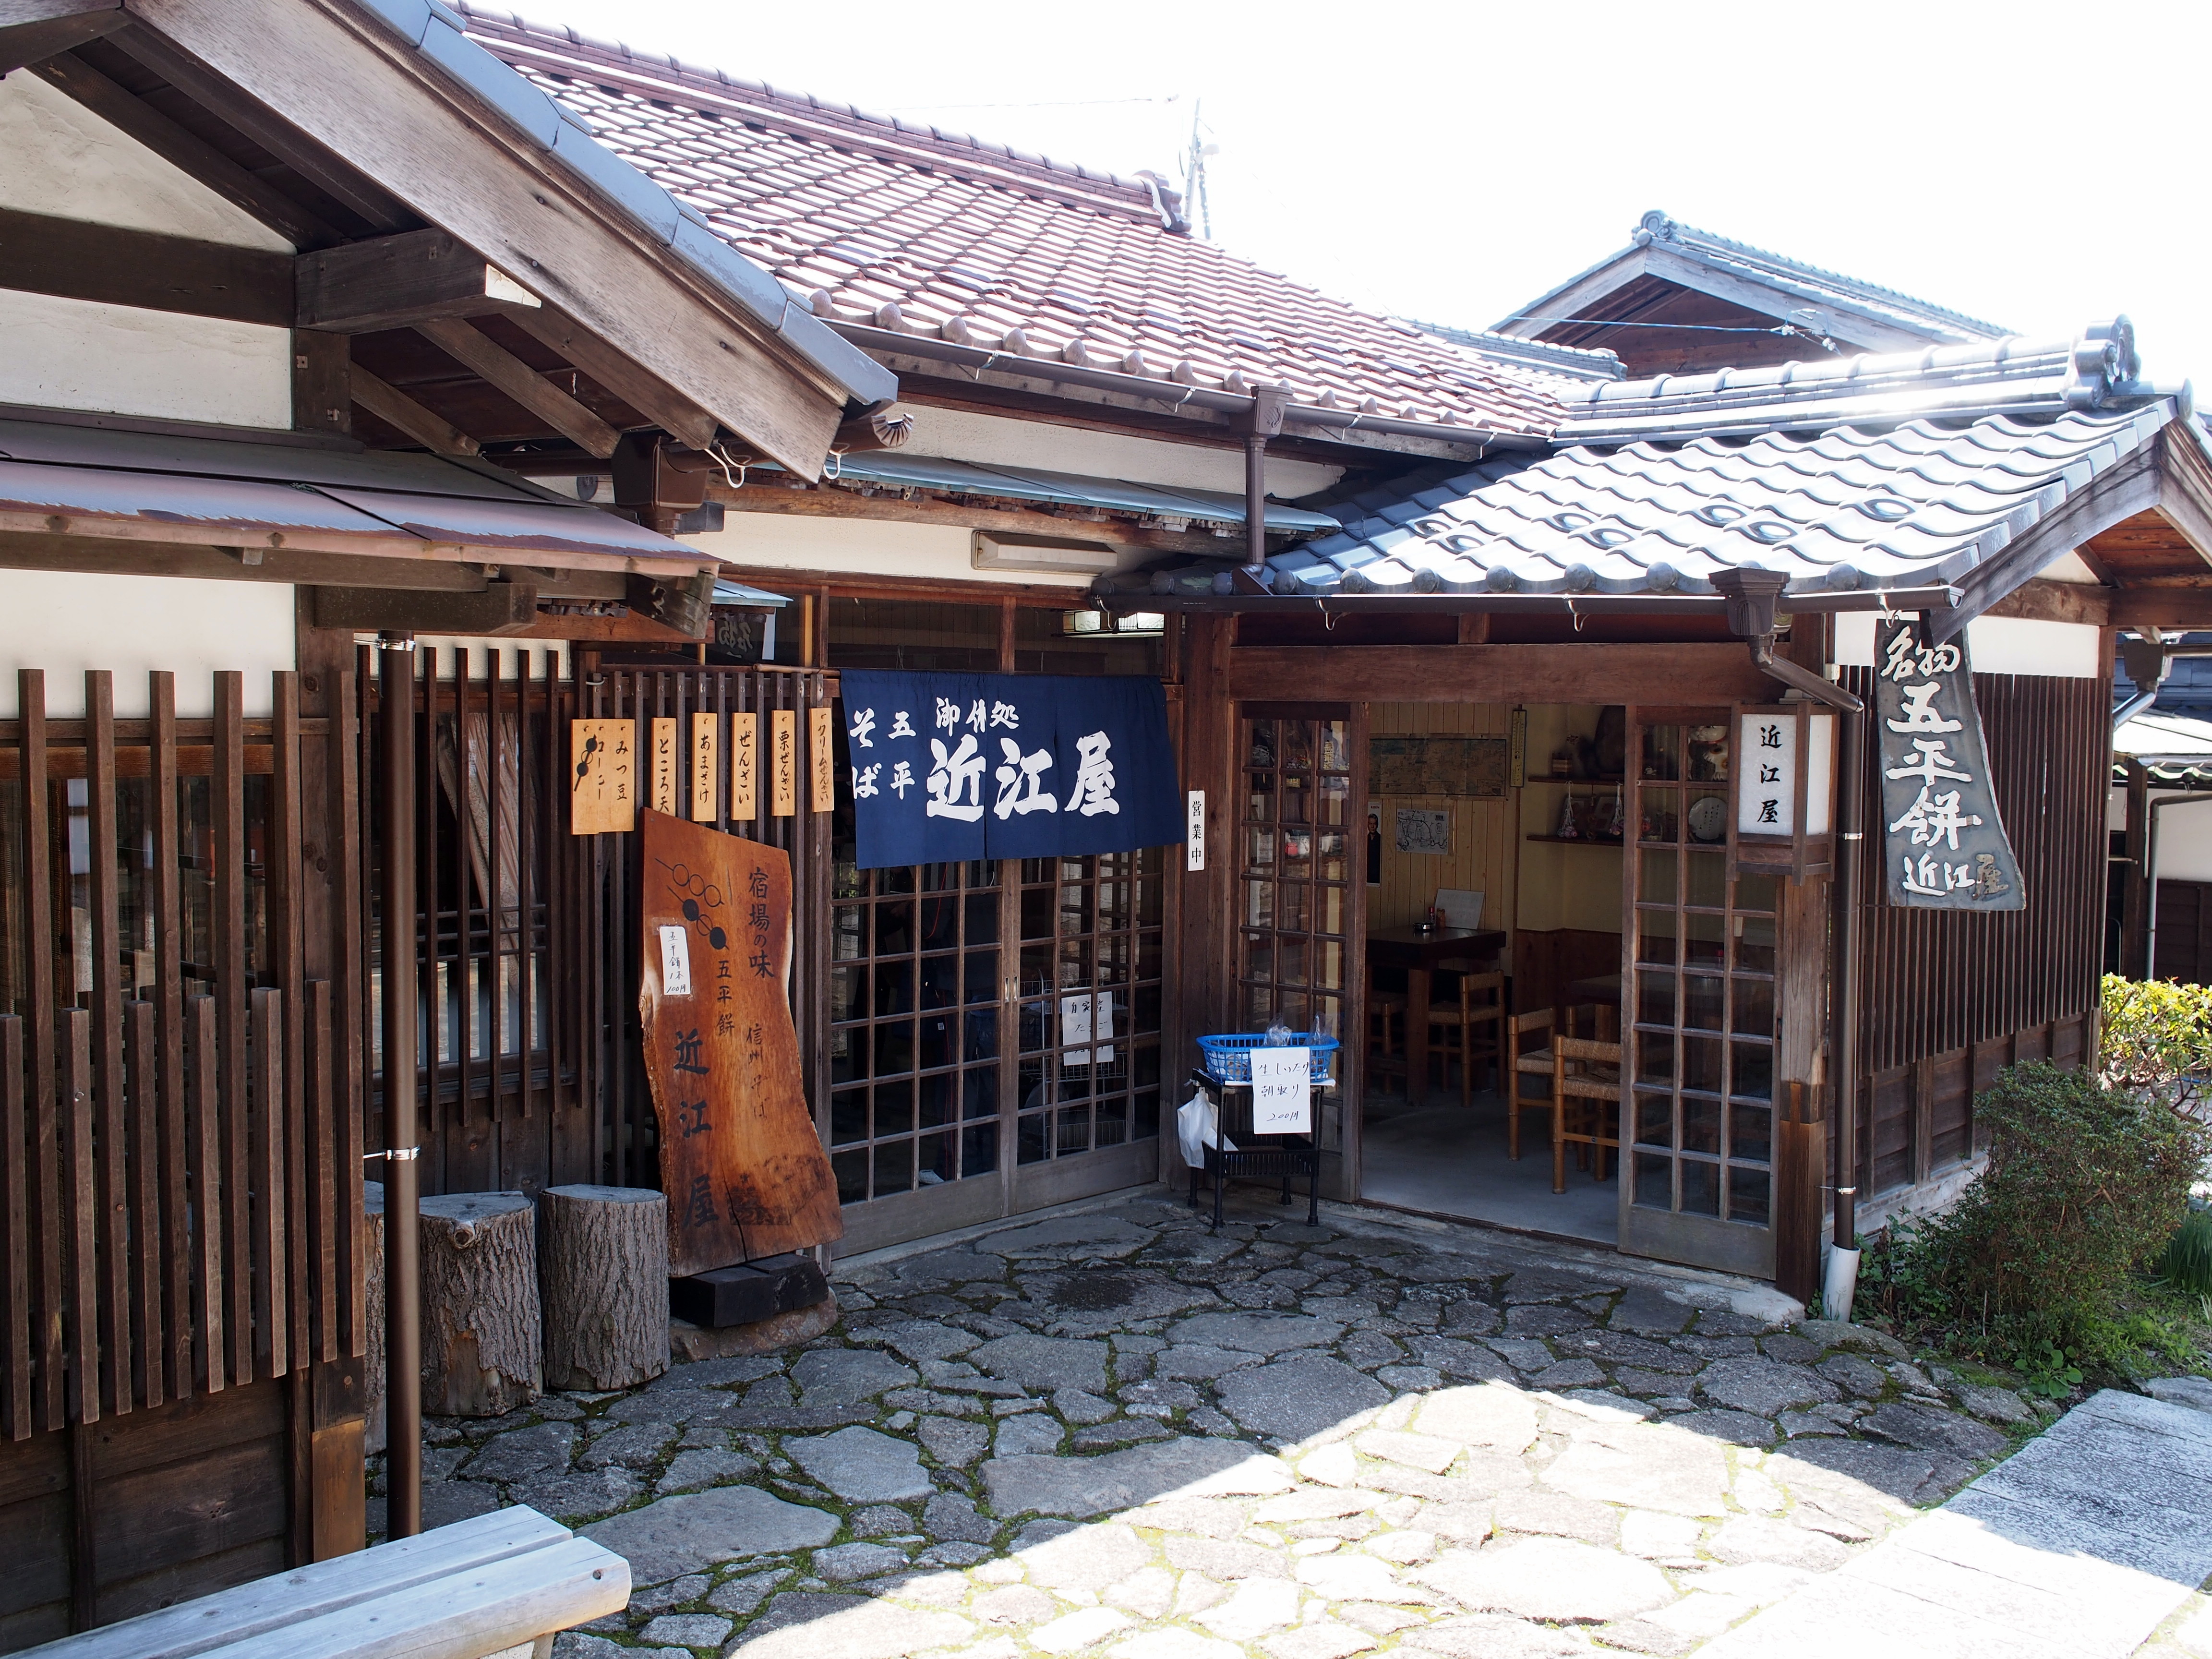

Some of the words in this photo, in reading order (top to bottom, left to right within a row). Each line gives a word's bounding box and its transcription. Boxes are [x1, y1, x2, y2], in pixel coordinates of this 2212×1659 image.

[1880, 625, 1960, 682] 名物
[849, 707, 882, 800] そば
[936, 696, 1020, 737] 御休処
[616, 740, 629, 800] みつ豆
[660, 738, 669, 812] ところ天
[700, 733, 710, 804] あまざけ
[739, 730, 752, 804] ぜんざい
[779, 730, 790, 802] 栗ぜんざい
[818, 724, 829, 802] クリームぜんざい
[888, 710, 916, 800] 五平
[926, 730, 1120, 823] 近江屋
[1757, 724, 1783, 823] 近江屋
[1886, 681, 1983, 851] 五平餅
[1191, 800, 1202, 863] 営業中
[1902, 852, 2009, 900] 近江屋
[748, 866, 775, 979] 宿場の味
[666, 984, 686, 993] 100円
[670, 971, 684, 980] 1本
[716, 960, 735, 1036] 五平餅
[745, 1022, 771, 1119] 信州そば
[1261, 1084, 1299, 1099] 朝取り
[673, 1028, 719, 1228] 近江屋
[1266, 1111, 1299, 1121] 200円
